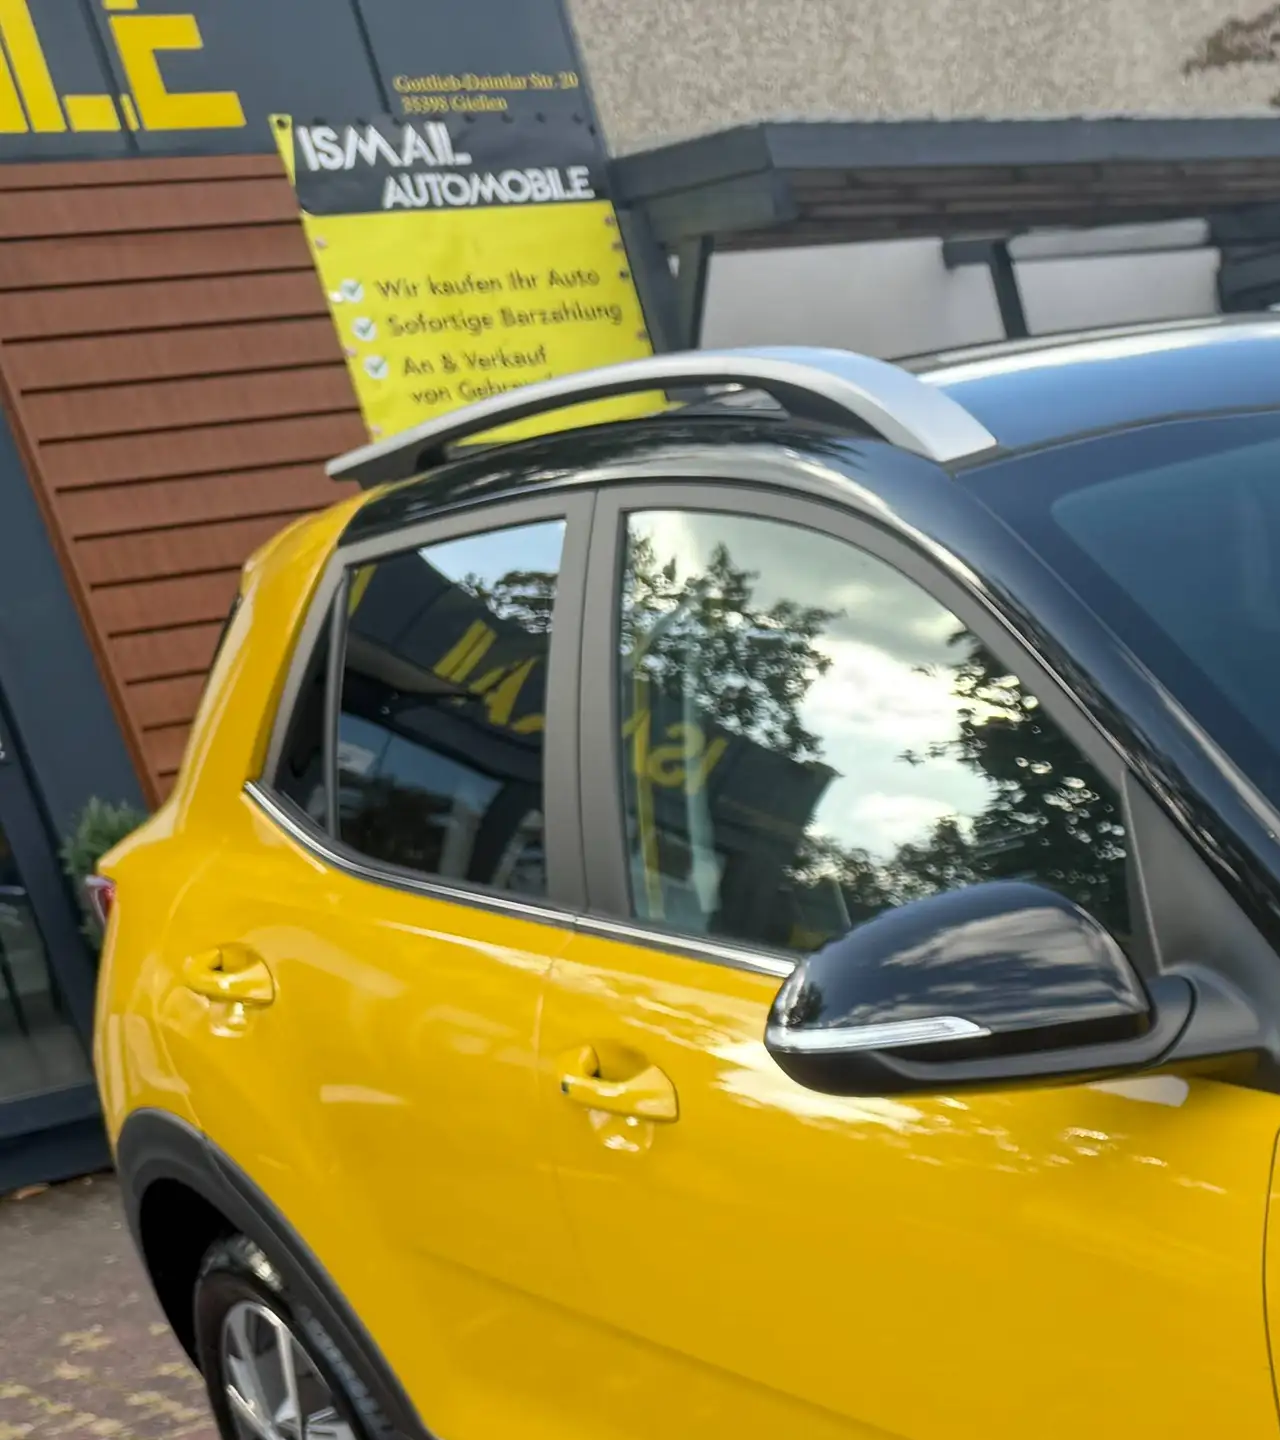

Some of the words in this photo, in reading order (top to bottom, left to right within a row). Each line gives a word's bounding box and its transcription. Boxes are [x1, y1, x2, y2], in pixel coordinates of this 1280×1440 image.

[558, 70, 579, 89] 20
[296, 121, 472, 171] ISMAIL
[382, 166, 596, 209] AUTOMOBILE
[376, 279, 419, 299] Wir
[429, 274, 503, 297] kaufen
[508, 269, 538, 290] Ihr
[548, 268, 600, 287] Auto
[387, 312, 494, 337] Sofortige
[500, 301, 622, 327] Barzahlung
[403, 356, 434, 376] An
[442, 355, 457, 373] &
[465, 345, 547, 369] Verkauf
[411, 388, 453, 405] von
